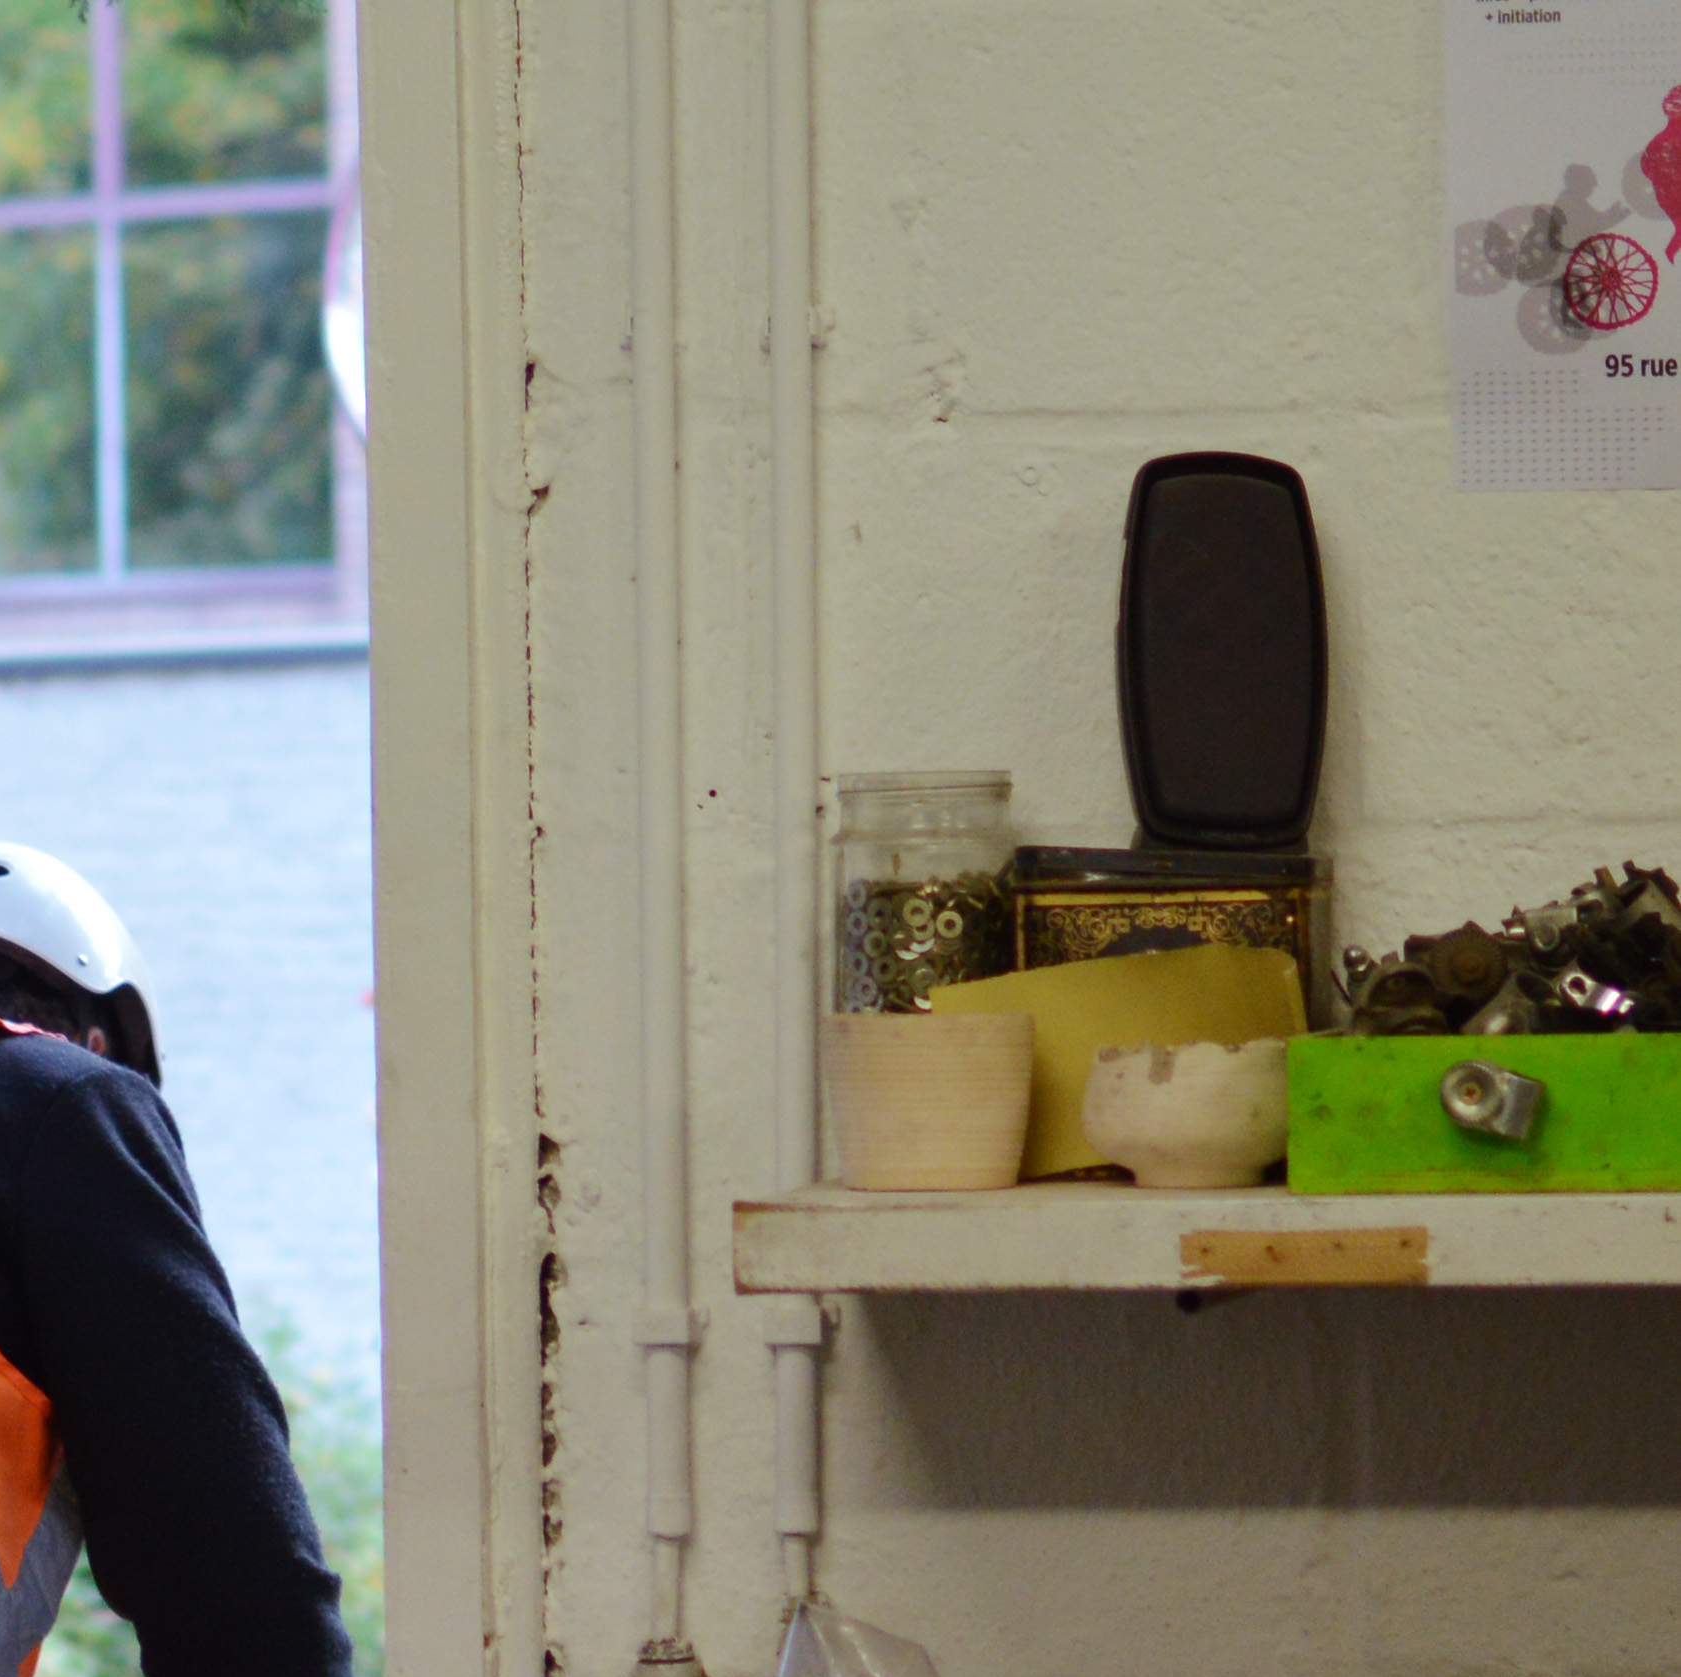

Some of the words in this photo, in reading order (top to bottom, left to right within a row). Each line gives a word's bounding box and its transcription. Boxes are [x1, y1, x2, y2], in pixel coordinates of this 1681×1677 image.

[1497, 9, 1562, 23] initiation
[1605, 354, 1634, 378] 95
[1640, 358, 1679, 377] rue
